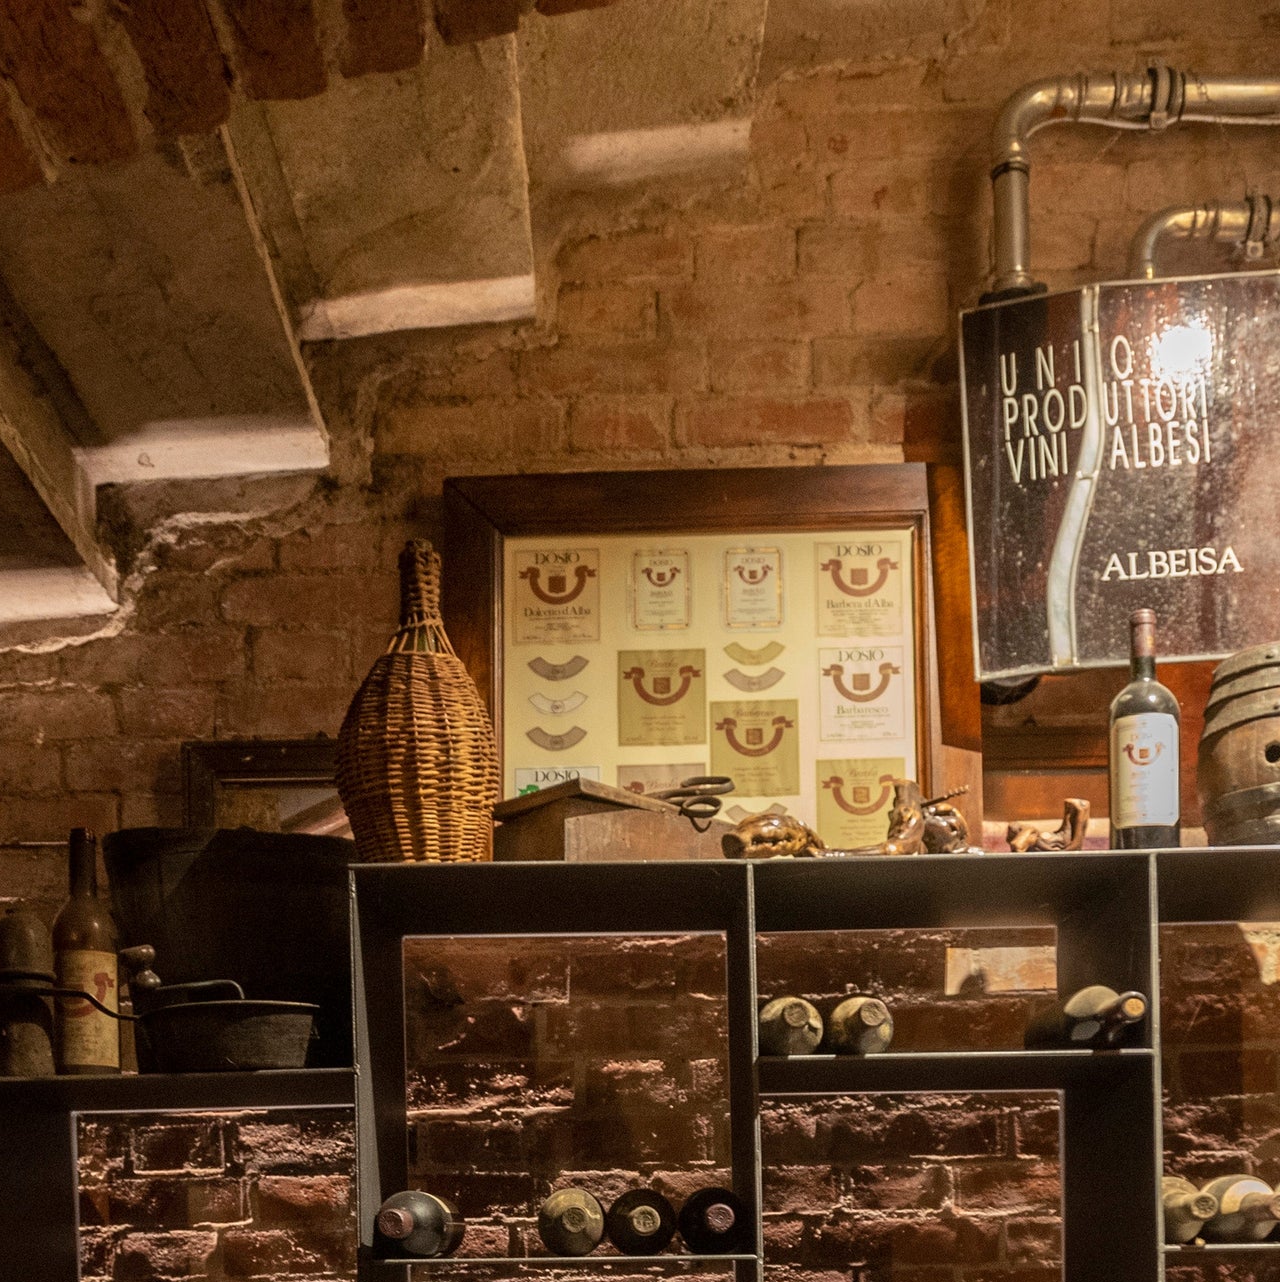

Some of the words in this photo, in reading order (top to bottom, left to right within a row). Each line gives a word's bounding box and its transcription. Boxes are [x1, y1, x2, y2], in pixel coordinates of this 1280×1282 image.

[1000, 330, 1207, 396] UNIO
[1003, 377, 1209, 440] PRODUTTORI
[1006, 431, 1068, 483] VINI
[1110, 417, 1211, 470] ALBESI
[534, 552, 580, 565] DOSIO
[837, 544, 882, 557] DOSIO
[1101, 546, 1244, 581] ALBEISA
[838, 649, 884, 662] DOSIO
